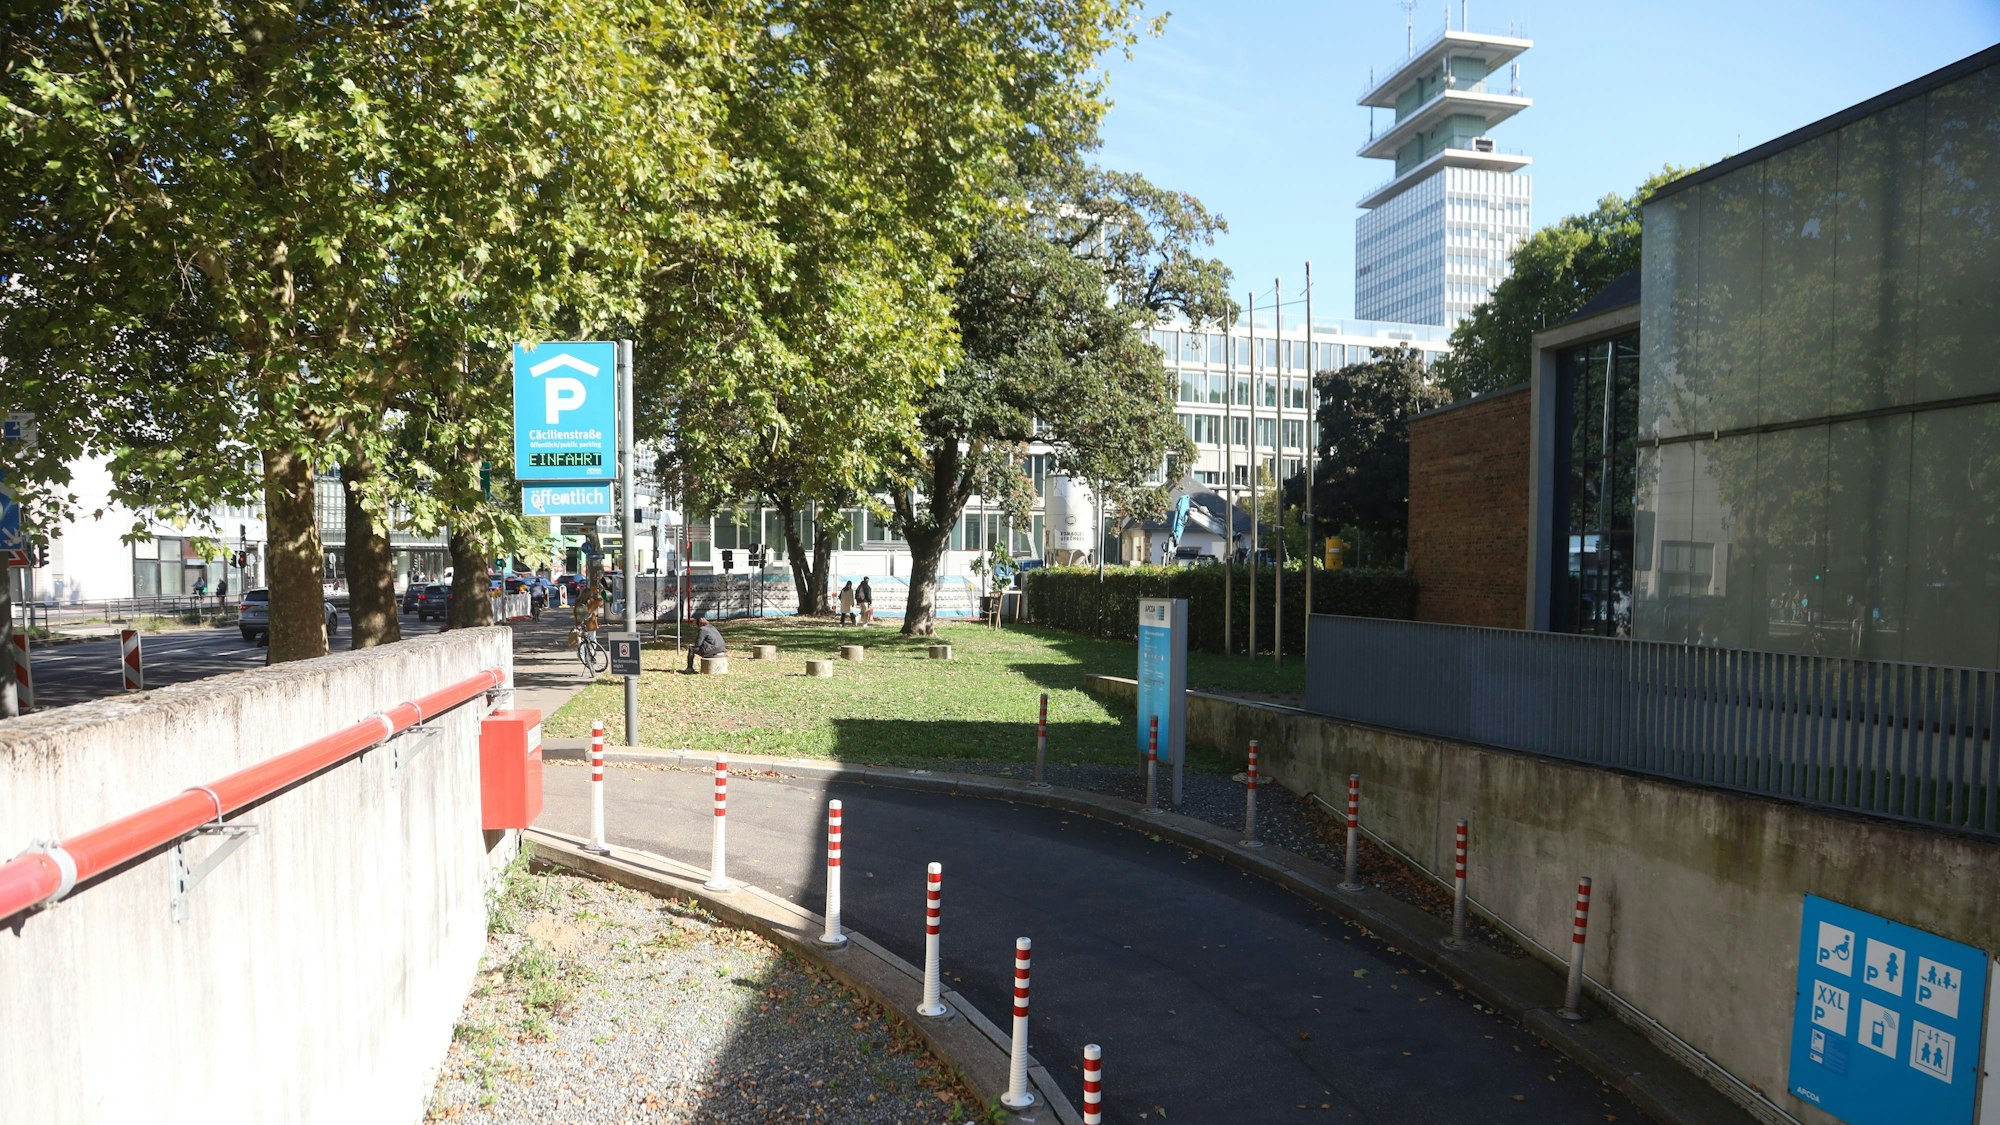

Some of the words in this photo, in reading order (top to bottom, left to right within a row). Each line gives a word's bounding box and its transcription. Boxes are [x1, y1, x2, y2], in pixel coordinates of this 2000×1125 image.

[546, 378, 586, 424] P
[529, 429, 602, 440] Cäcilienstraße
[529, 453, 602, 466] EINFAHRT
[531, 488, 604, 505] öffentlich
[1819, 948, 1830, 963] P
[1866, 965, 1879, 981] P
[1817, 985, 1844, 1011] XXL
[1919, 985, 1932, 1002] P
[1814, 1005, 1825, 1021] P
[1796, 1086, 1820, 1103] APCOA
